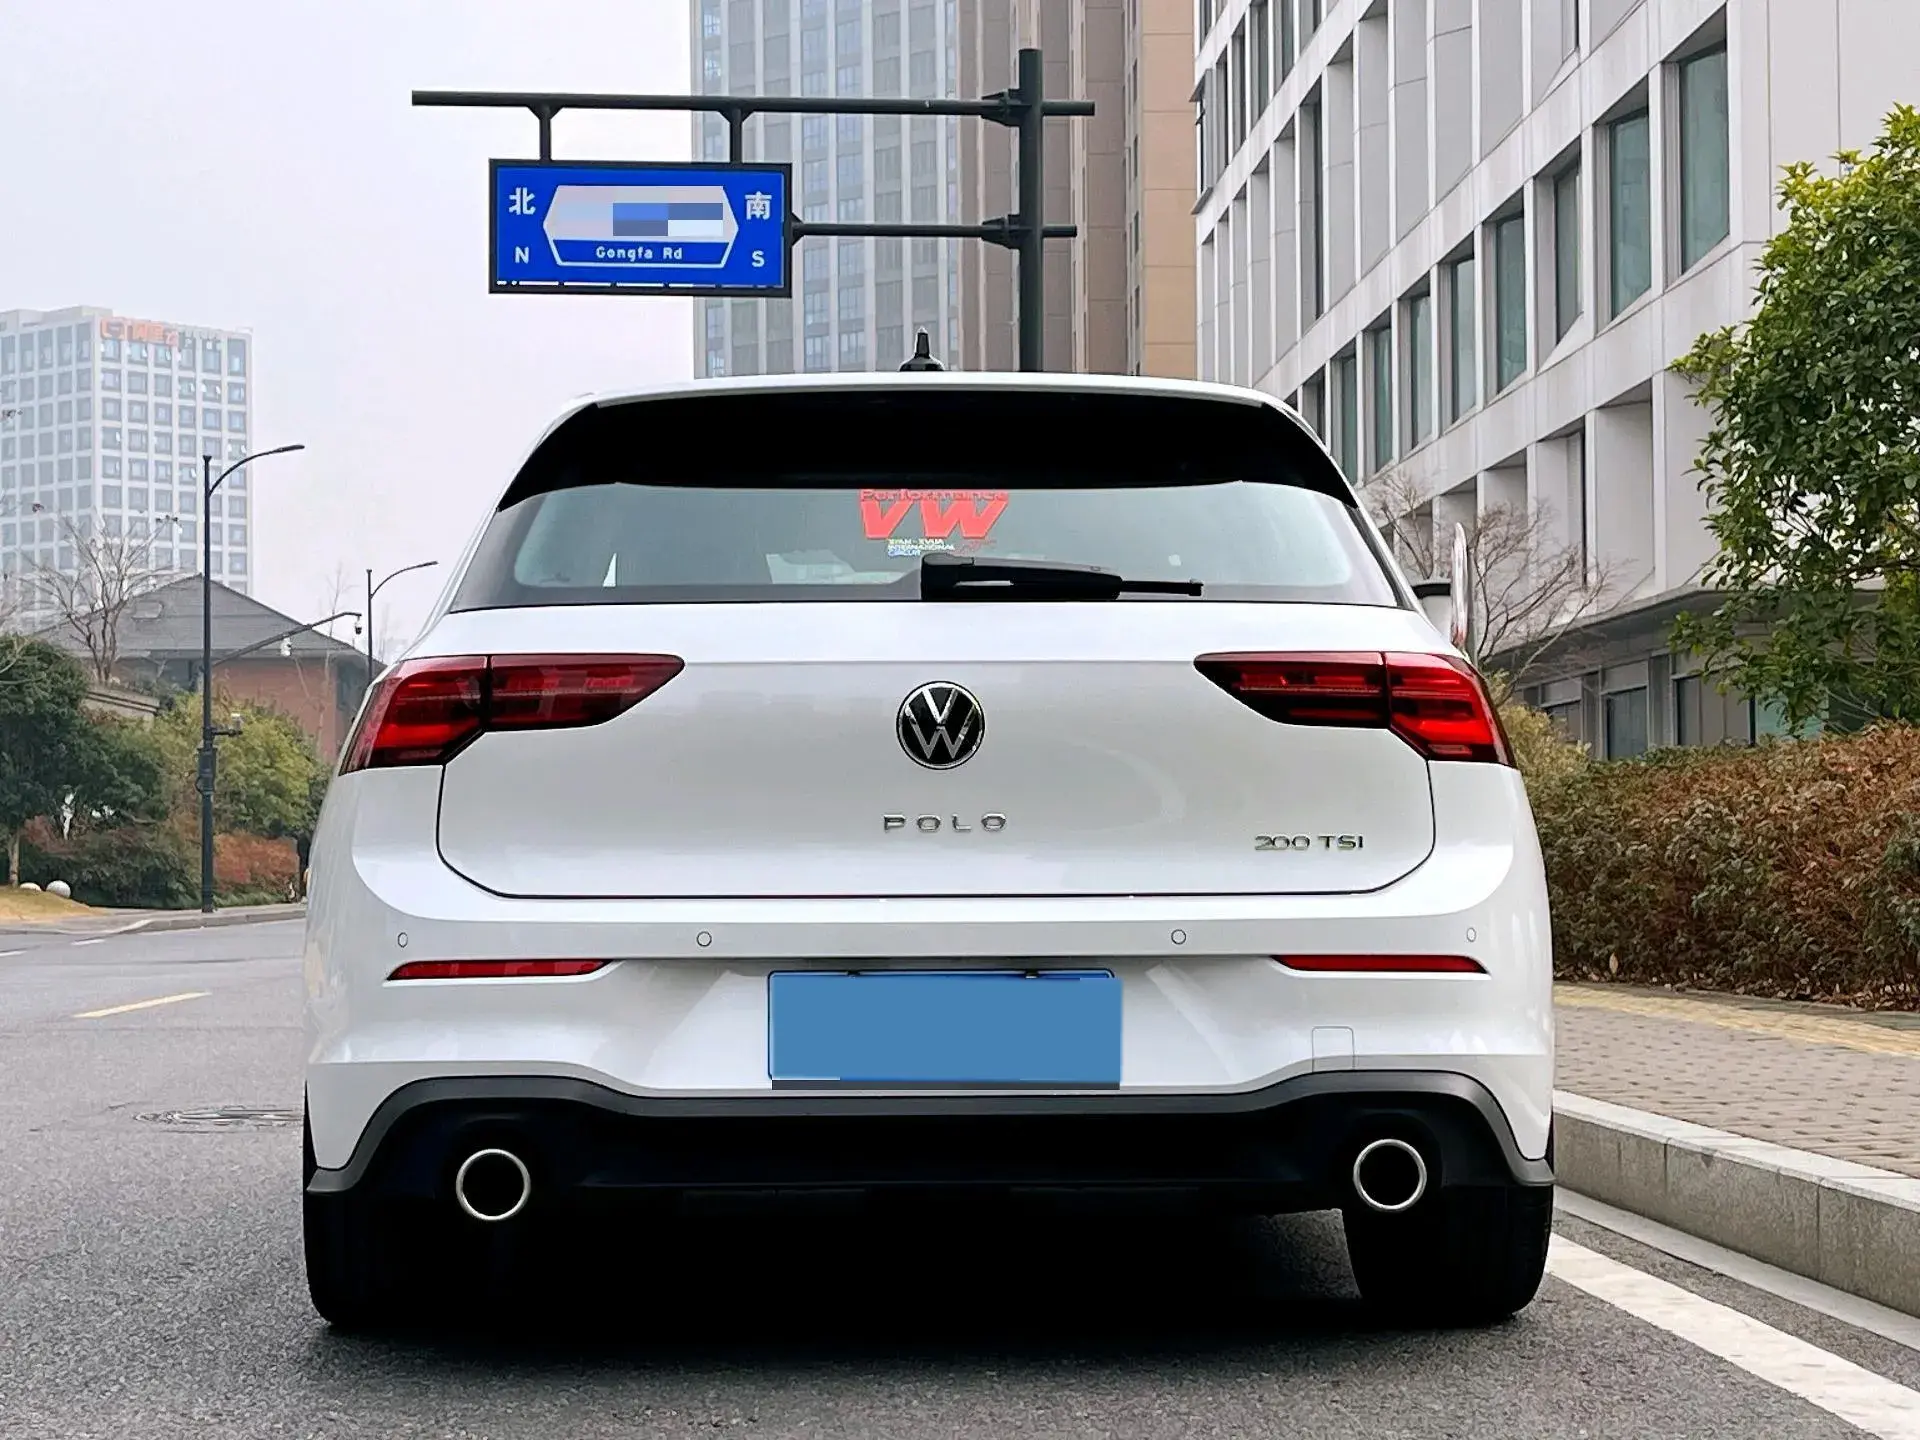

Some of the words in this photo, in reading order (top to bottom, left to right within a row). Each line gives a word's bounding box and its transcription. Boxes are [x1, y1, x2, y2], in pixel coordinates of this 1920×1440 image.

[509, 187, 536, 215] 北
[745, 191, 772, 220] 南
[515, 247, 529, 264] N
[596, 246, 653, 262] Gongfa
[663, 247, 683, 260] Rd
[751, 250, 766, 268] S
[861, 500, 1009, 539] VW
[884, 813, 1007, 832] POLO
[1255, 834, 1310, 850] 200
[1318, 835, 1363, 849] TSI
